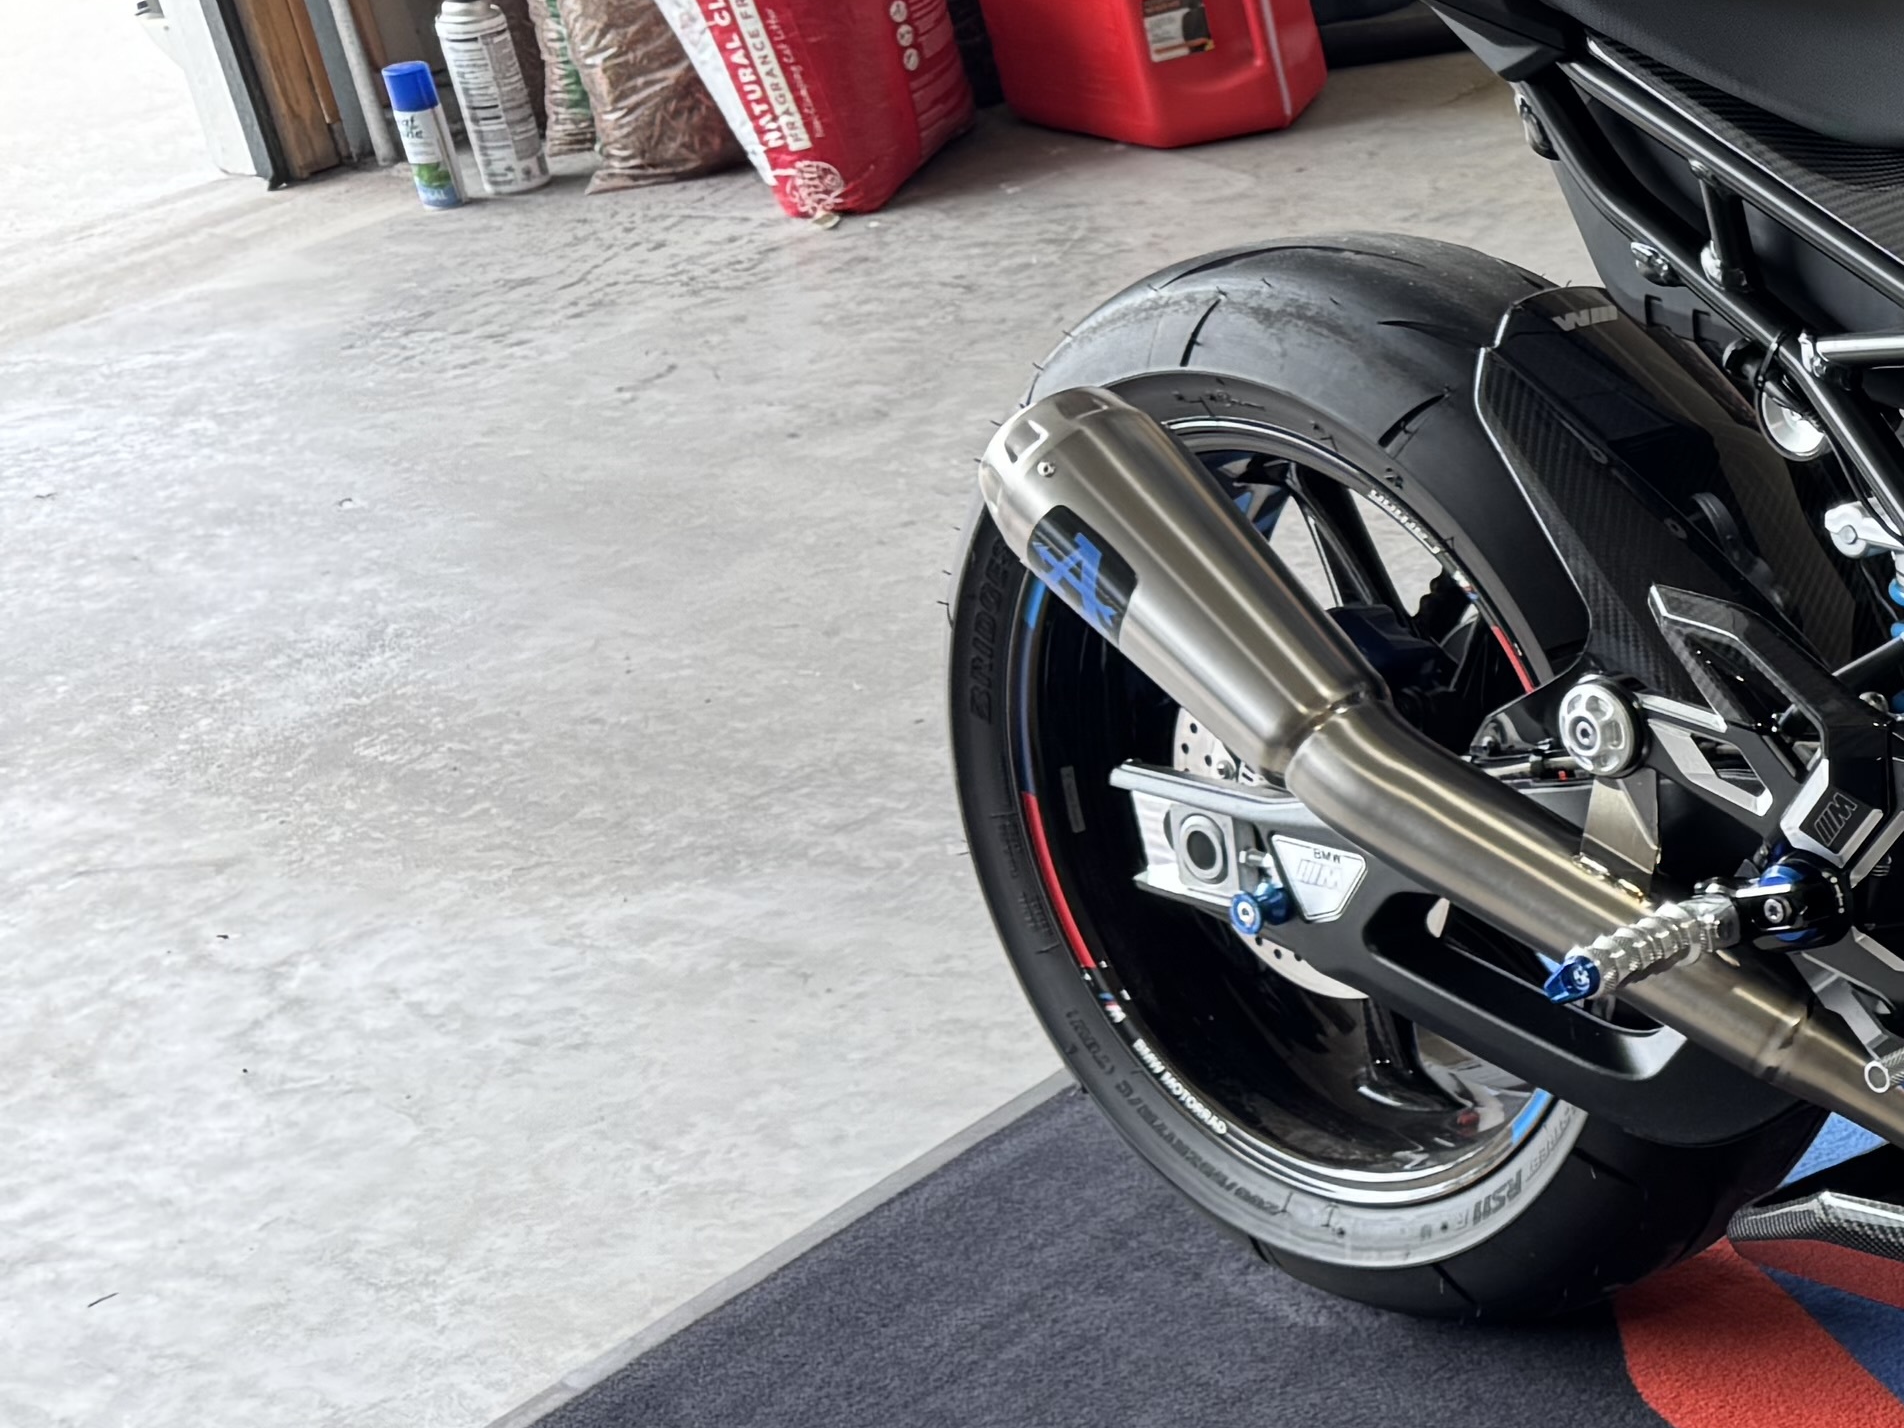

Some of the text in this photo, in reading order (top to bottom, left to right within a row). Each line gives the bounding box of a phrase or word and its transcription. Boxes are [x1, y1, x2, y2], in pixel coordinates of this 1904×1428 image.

[725, 31, 787, 149] NATURAL
[748, 29, 803, 144] FRAGRANCE
[1312, 847, 1342, 864] BMW
